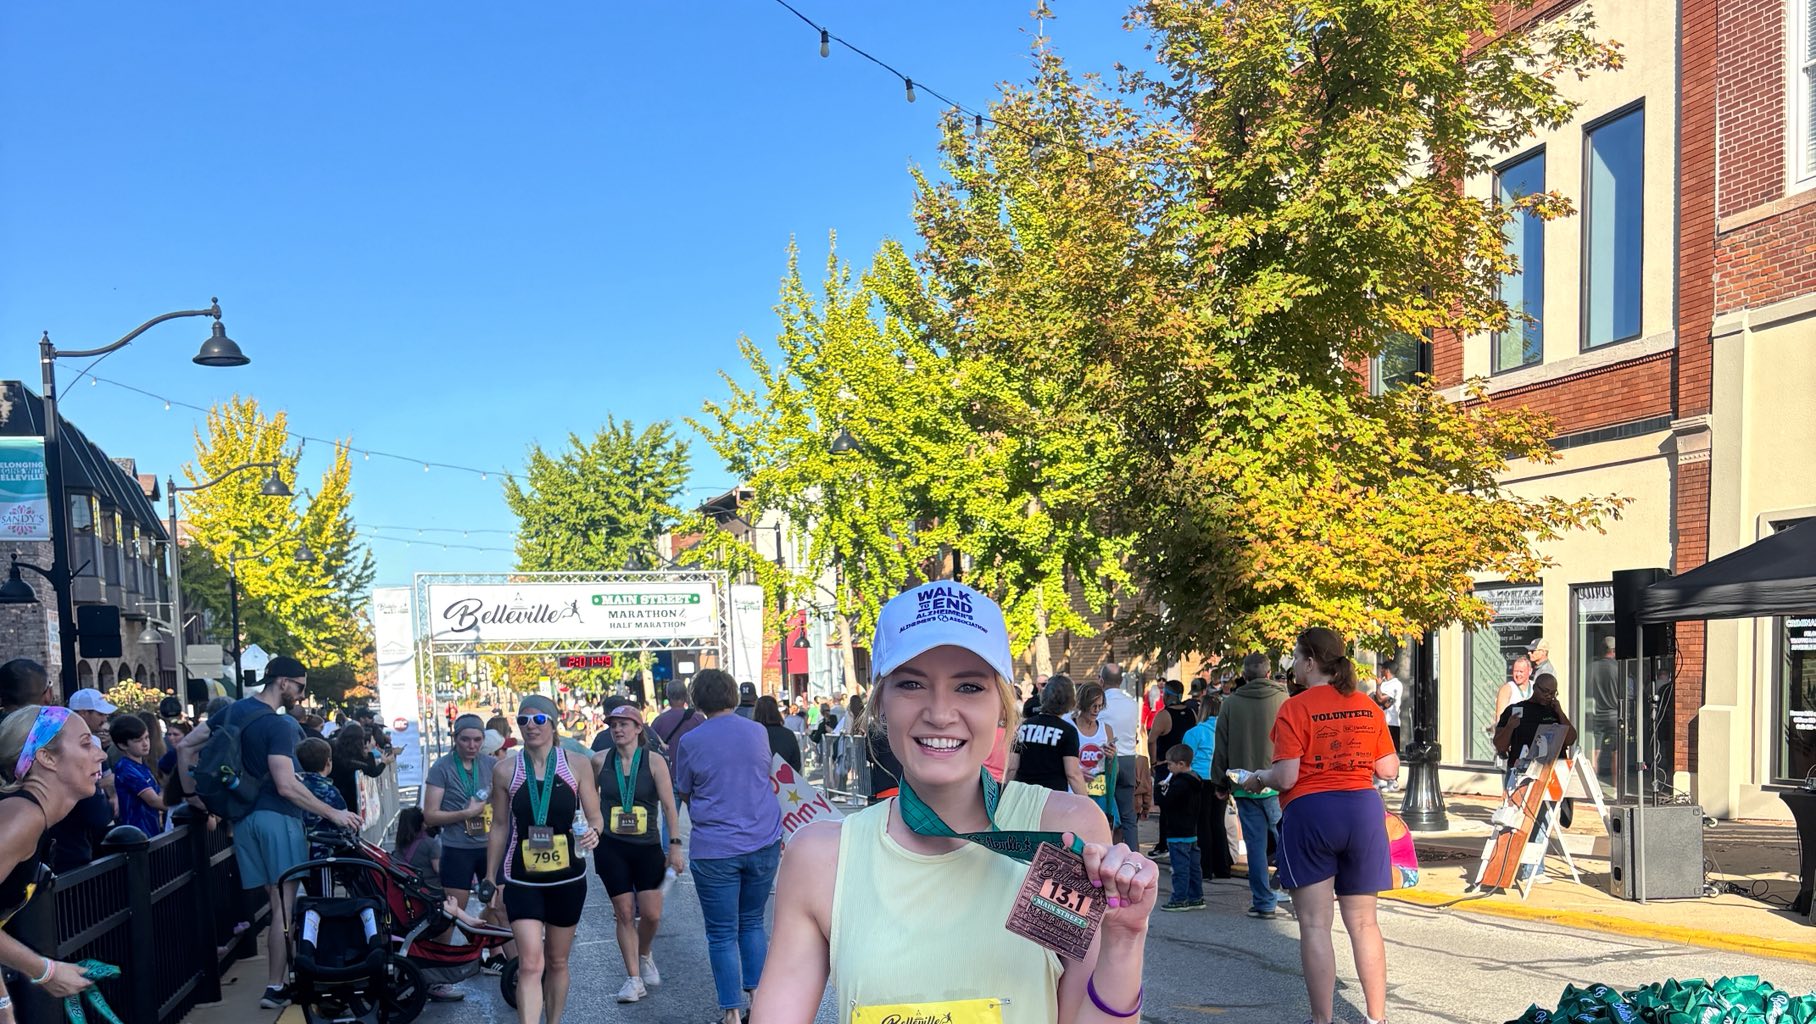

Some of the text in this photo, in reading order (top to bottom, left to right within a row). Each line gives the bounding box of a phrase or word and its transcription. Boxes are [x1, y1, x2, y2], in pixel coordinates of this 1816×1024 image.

[0, 473, 44, 481] ELLEVILLE
[1, 514, 44, 523] SANDY'S
[602, 594, 691, 605] MAIN STREET
[917, 587, 972, 603] WALK
[932, 598, 973, 614] END
[443, 598, 559, 632] Belleville
[608, 609, 677, 618] MARATHON
[915, 610, 974, 621] ALZHEIMER'S
[899, 617, 937, 633] ALZHEIMER'S
[1312, 710, 1373, 722] VOLUNTEER
[1018, 724, 1064, 747] STAFF
[533, 851, 560, 864] 796
[1049, 881, 1086, 912] 13.1
[1037, 898, 1085, 925] MAIN STREET
